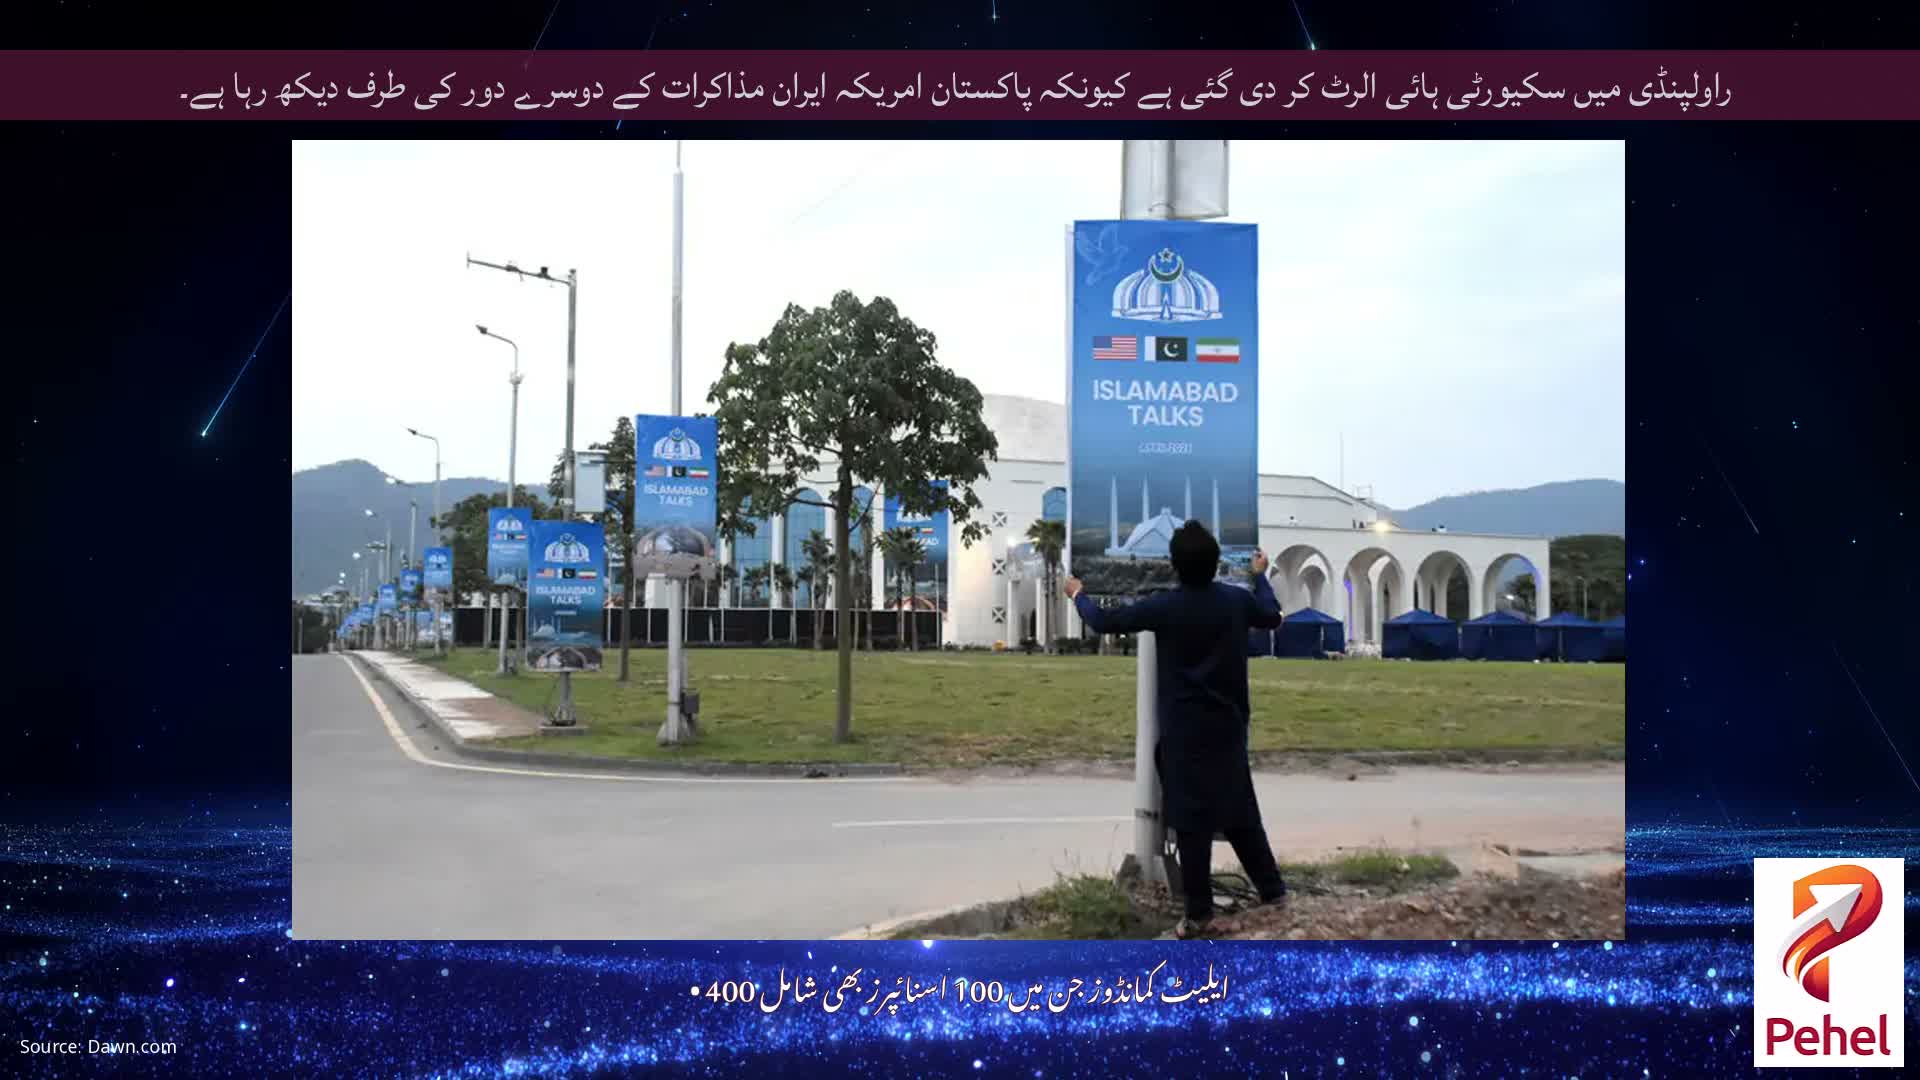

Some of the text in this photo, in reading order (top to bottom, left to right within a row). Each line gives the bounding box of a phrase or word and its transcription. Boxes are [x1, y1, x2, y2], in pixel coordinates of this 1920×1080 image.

[1092, 379, 1239, 403] ISLAMABAD
[1128, 404, 1204, 427] TALKS
[643, 484, 709, 497] ISLAMABAD
[659, 495, 693, 508] TALKS
